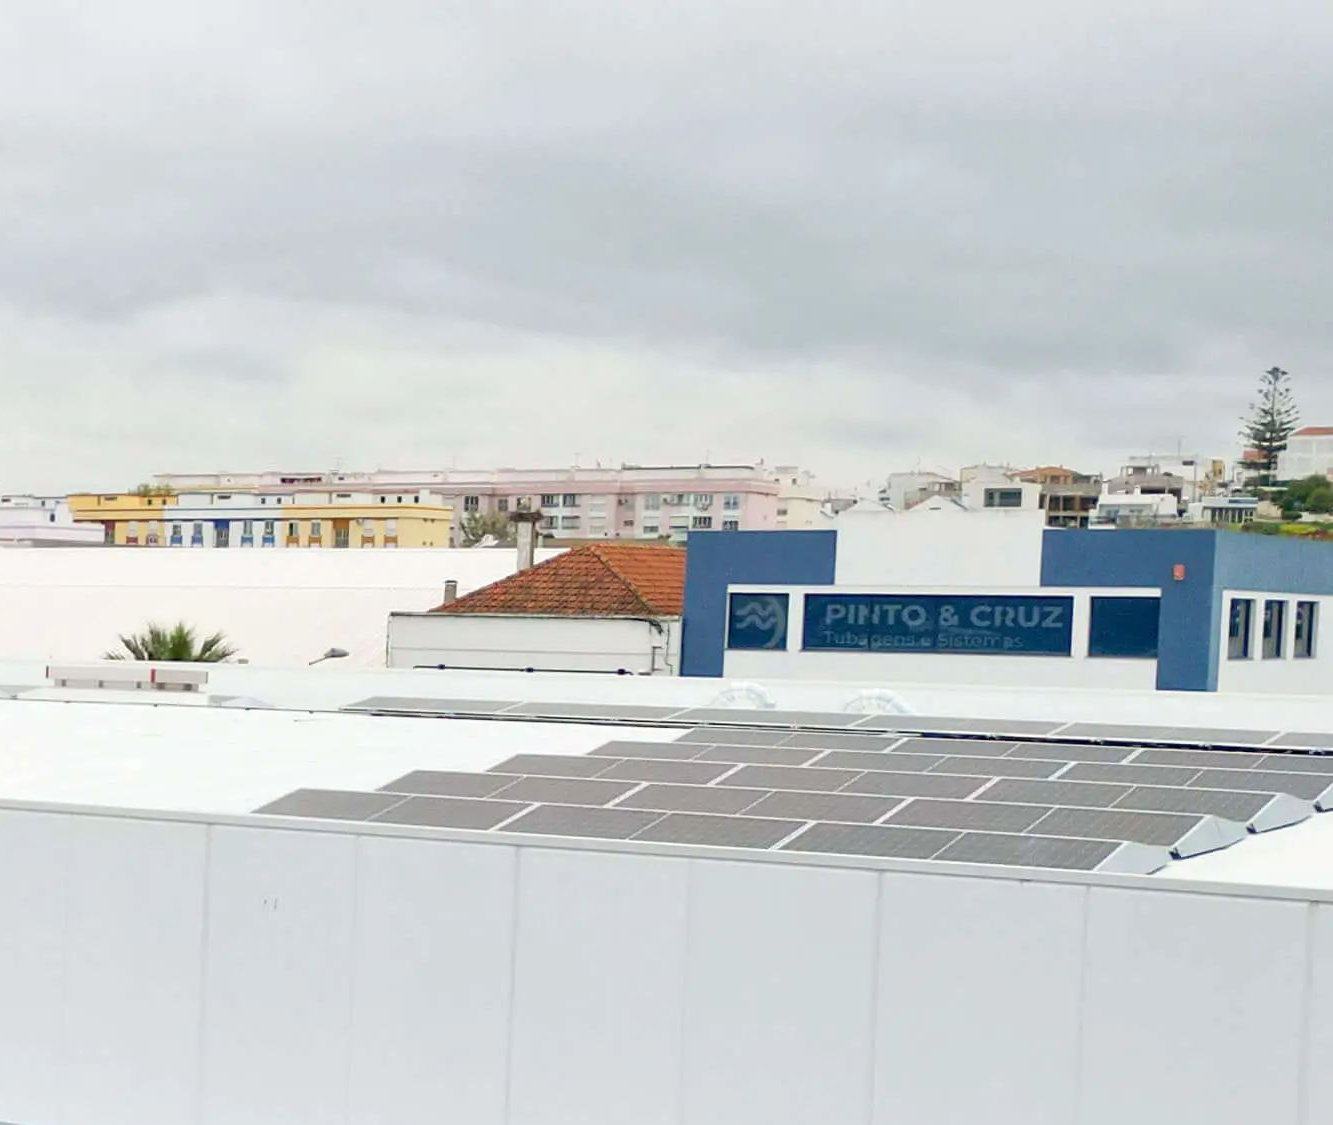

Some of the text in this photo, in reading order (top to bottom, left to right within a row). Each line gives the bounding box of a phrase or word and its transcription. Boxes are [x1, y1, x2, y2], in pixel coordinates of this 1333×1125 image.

[824, 604, 1063, 628] PINTO & CRUZ
